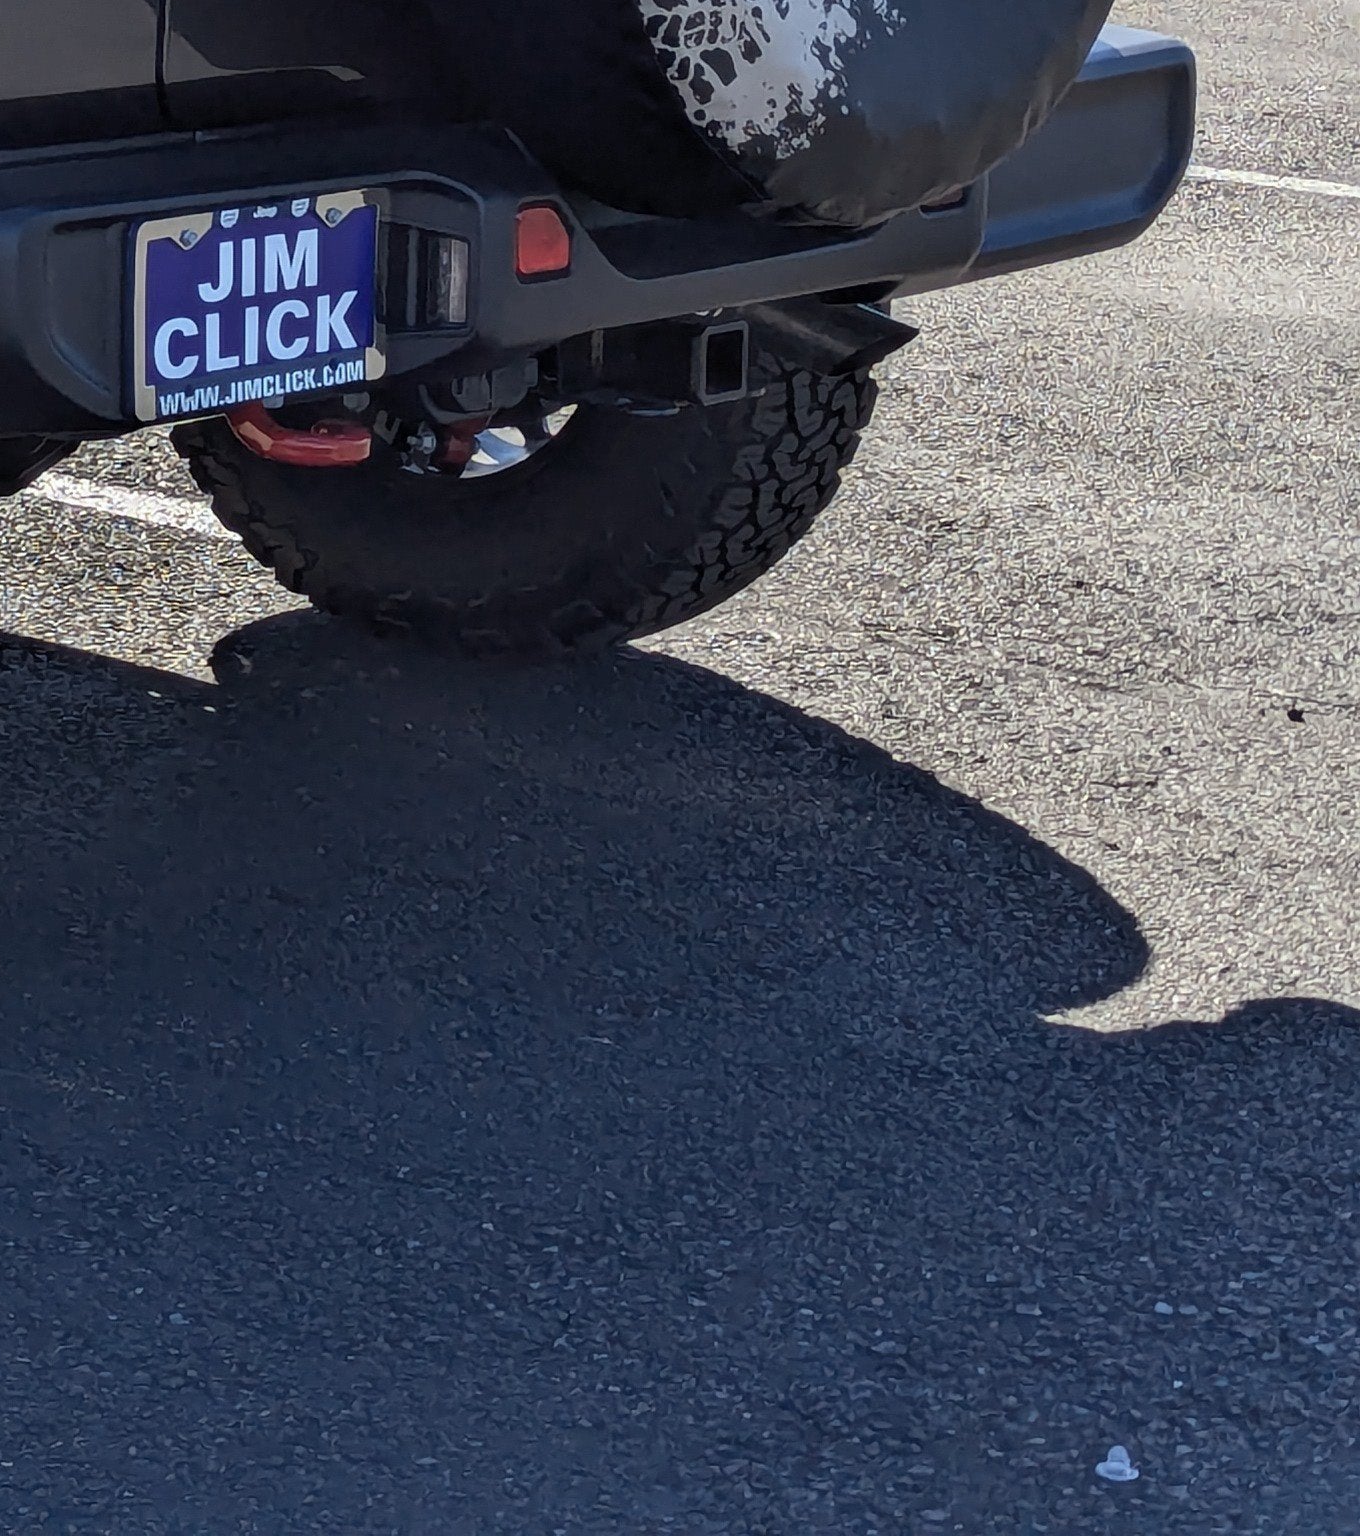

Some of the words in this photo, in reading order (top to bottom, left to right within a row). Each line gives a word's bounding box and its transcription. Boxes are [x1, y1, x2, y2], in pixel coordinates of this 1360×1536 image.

[198, 228, 318, 302] JIM
[153, 290, 358, 379] CLICK
[159, 360, 364, 416] WWW.JIMCLICK.COM
